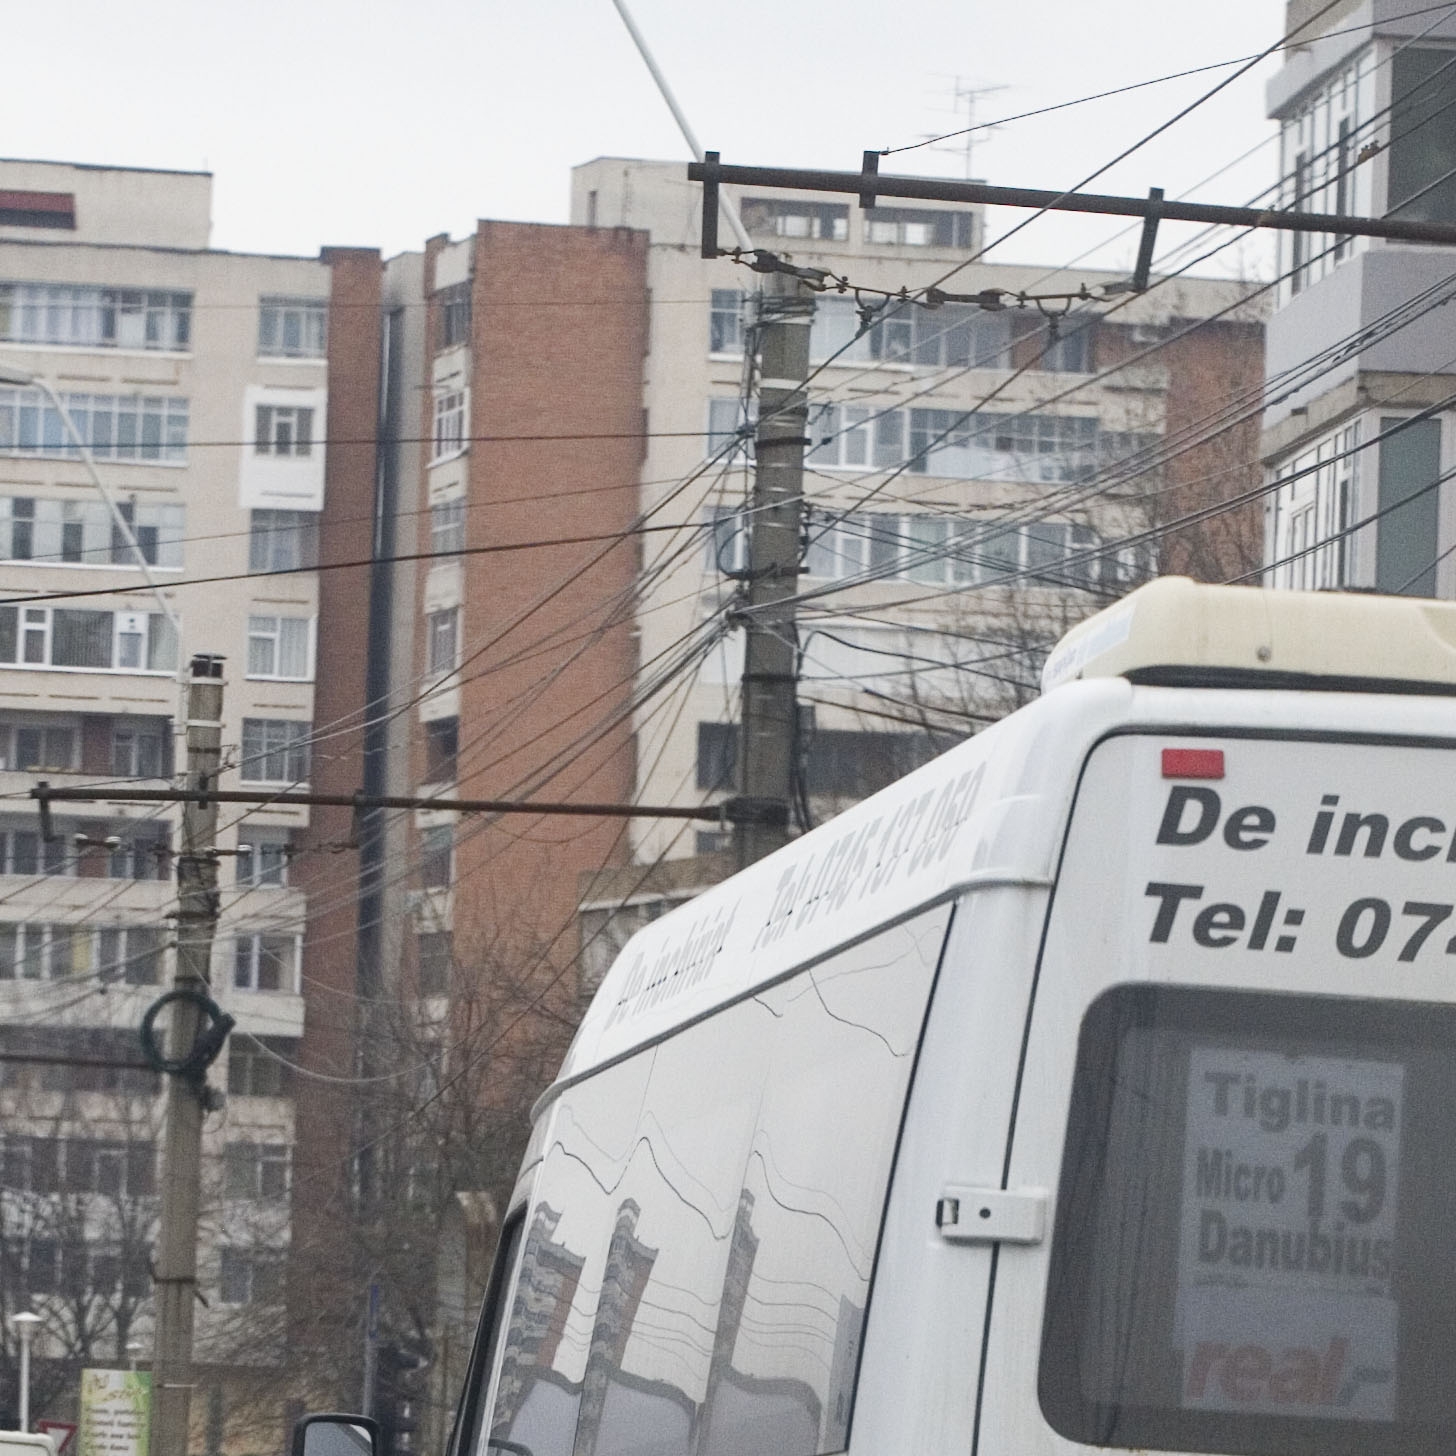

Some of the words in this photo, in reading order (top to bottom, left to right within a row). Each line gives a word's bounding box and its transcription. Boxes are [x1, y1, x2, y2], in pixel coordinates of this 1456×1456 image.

[1155, 785, 1277, 851] De
[1144, 883, 1306, 952] Tel:
[1205, 1070, 1396, 1133] Tiglina
[1194, 1147, 1285, 1204] Micro
[1293, 1132, 1386, 1226] 19
[1197, 1208, 1392, 1280] Danubius
